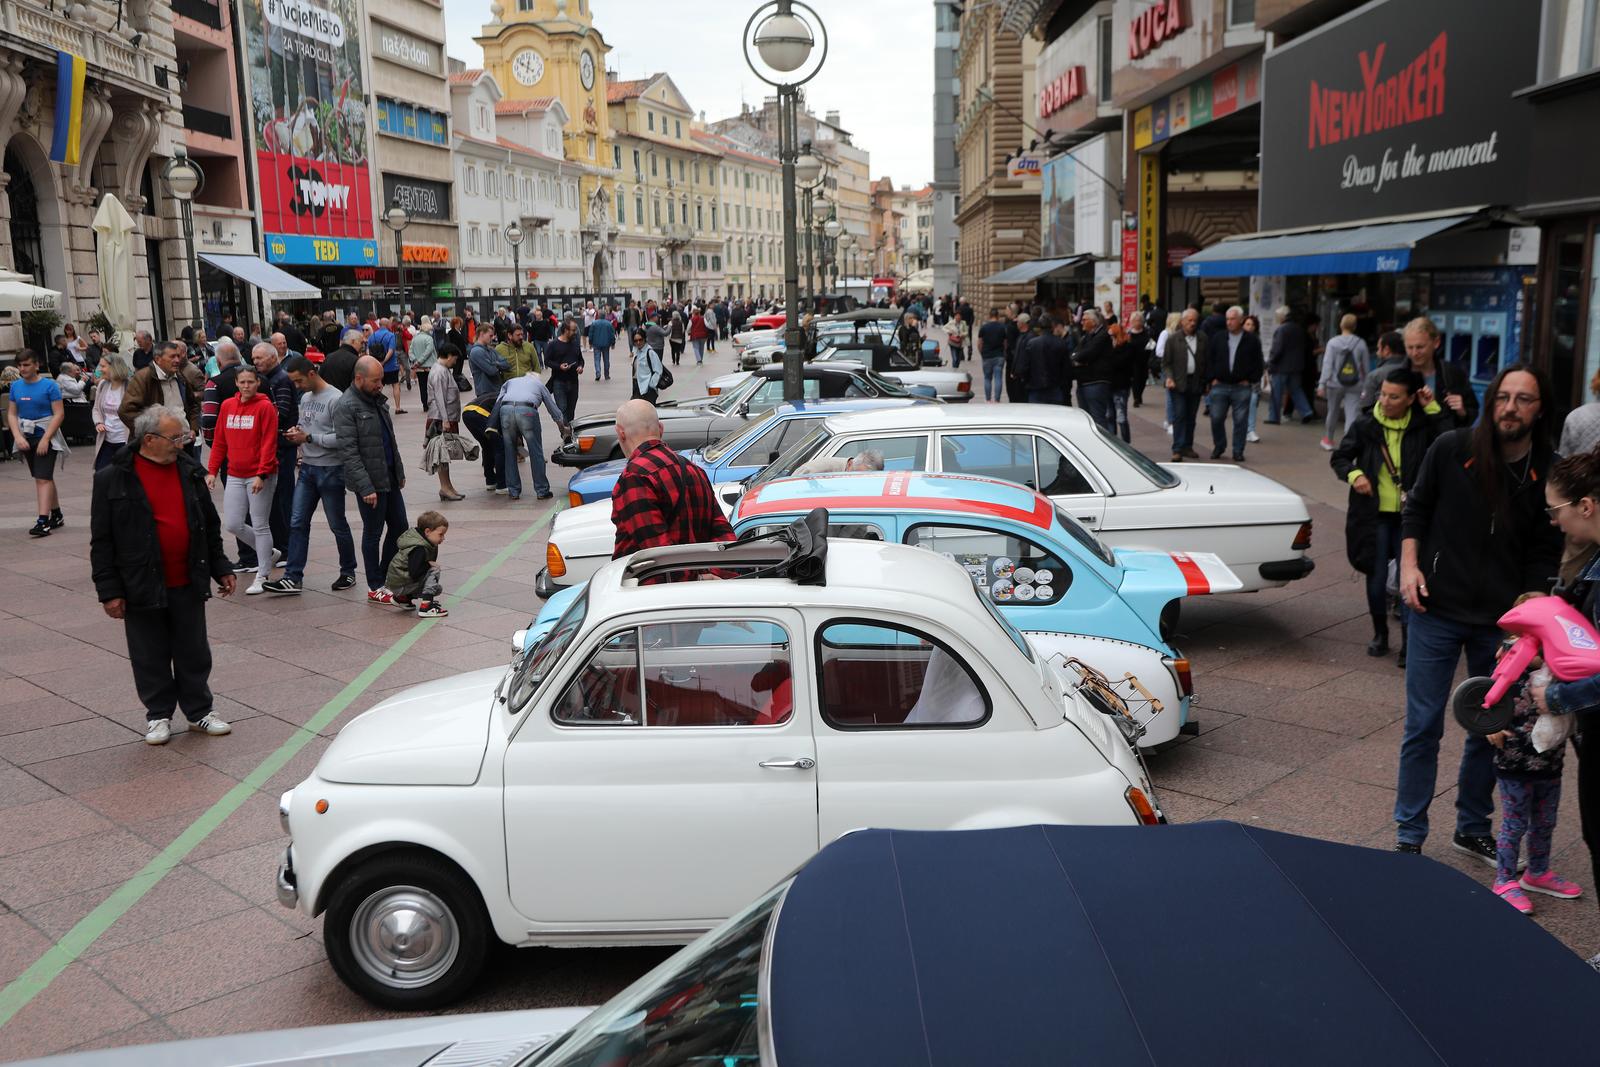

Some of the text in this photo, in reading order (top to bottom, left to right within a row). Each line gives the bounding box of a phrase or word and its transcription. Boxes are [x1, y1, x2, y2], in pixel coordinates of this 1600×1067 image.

[411, 42, 430, 68] dom
[1373, 148, 1399, 192] for
[1401, 143, 1426, 178] the
[300, 179, 350, 209] TOMMY
[271, 242, 286, 254] TEDi
[313, 240, 340, 261] TEDi
[402, 245, 448, 262] KORZO
